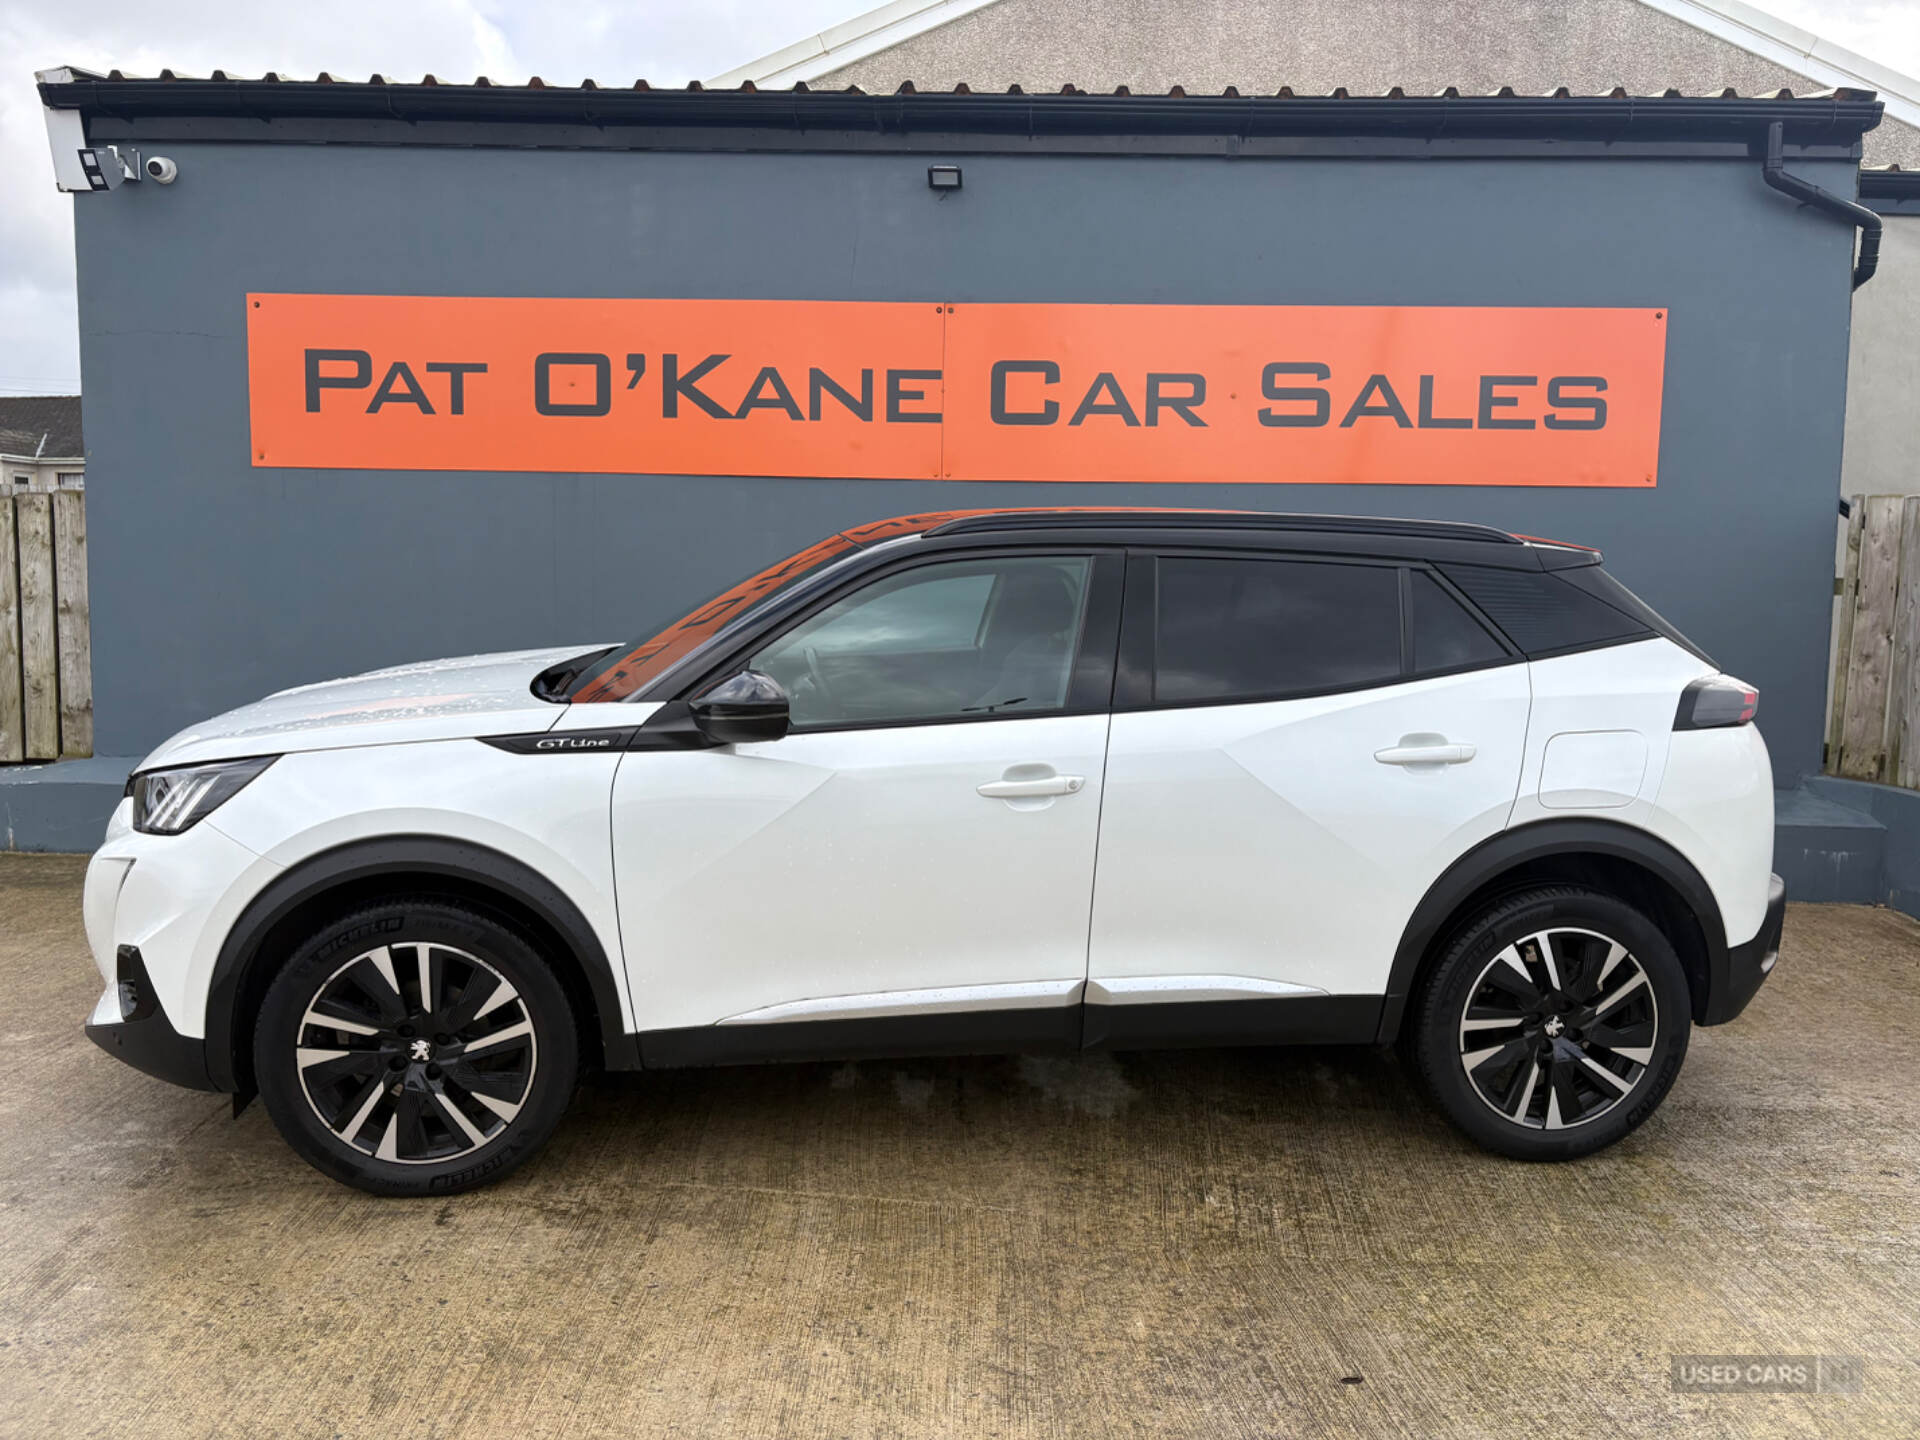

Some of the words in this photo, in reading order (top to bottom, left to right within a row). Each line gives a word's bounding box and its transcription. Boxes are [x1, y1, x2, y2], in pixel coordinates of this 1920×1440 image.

[304, 349, 488, 415] PAT
[534, 352, 943, 424] O'KANE
[990, 360, 1210, 428] CAR
[1257, 361, 1608, 431] SALES
[536, 738, 571, 749] GT
